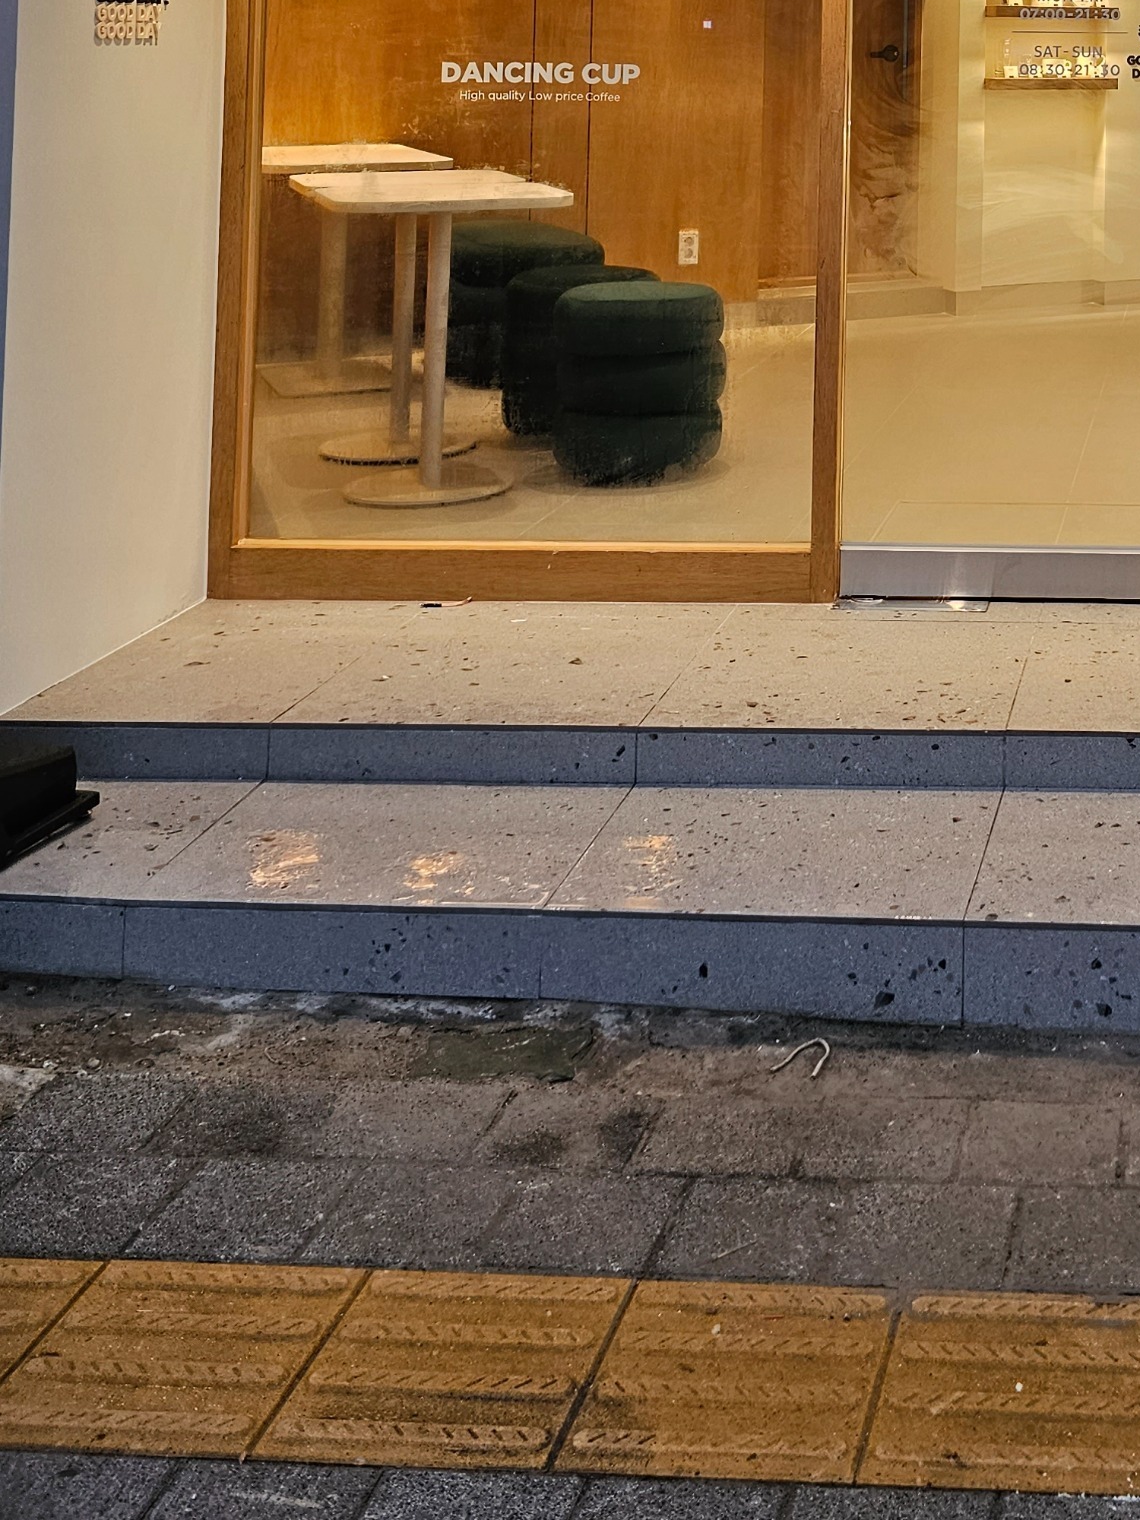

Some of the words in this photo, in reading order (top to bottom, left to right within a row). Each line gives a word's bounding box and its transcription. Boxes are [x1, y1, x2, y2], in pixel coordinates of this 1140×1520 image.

[95, 3, 136, 22] GOOD
[137, 4, 162, 24] DAY
[95, 21, 136, 40] GOOD
[137, 22, 162, 41] DAY
[441, 61, 574, 84] DANCING
[581, 62, 641, 85] CUP
[459, 89, 485, 102] High
[488, 89, 525, 102] quality
[529, 90, 554, 101] Low
[556, 90, 583, 103] price
[585, 91, 621, 102] Coffee
